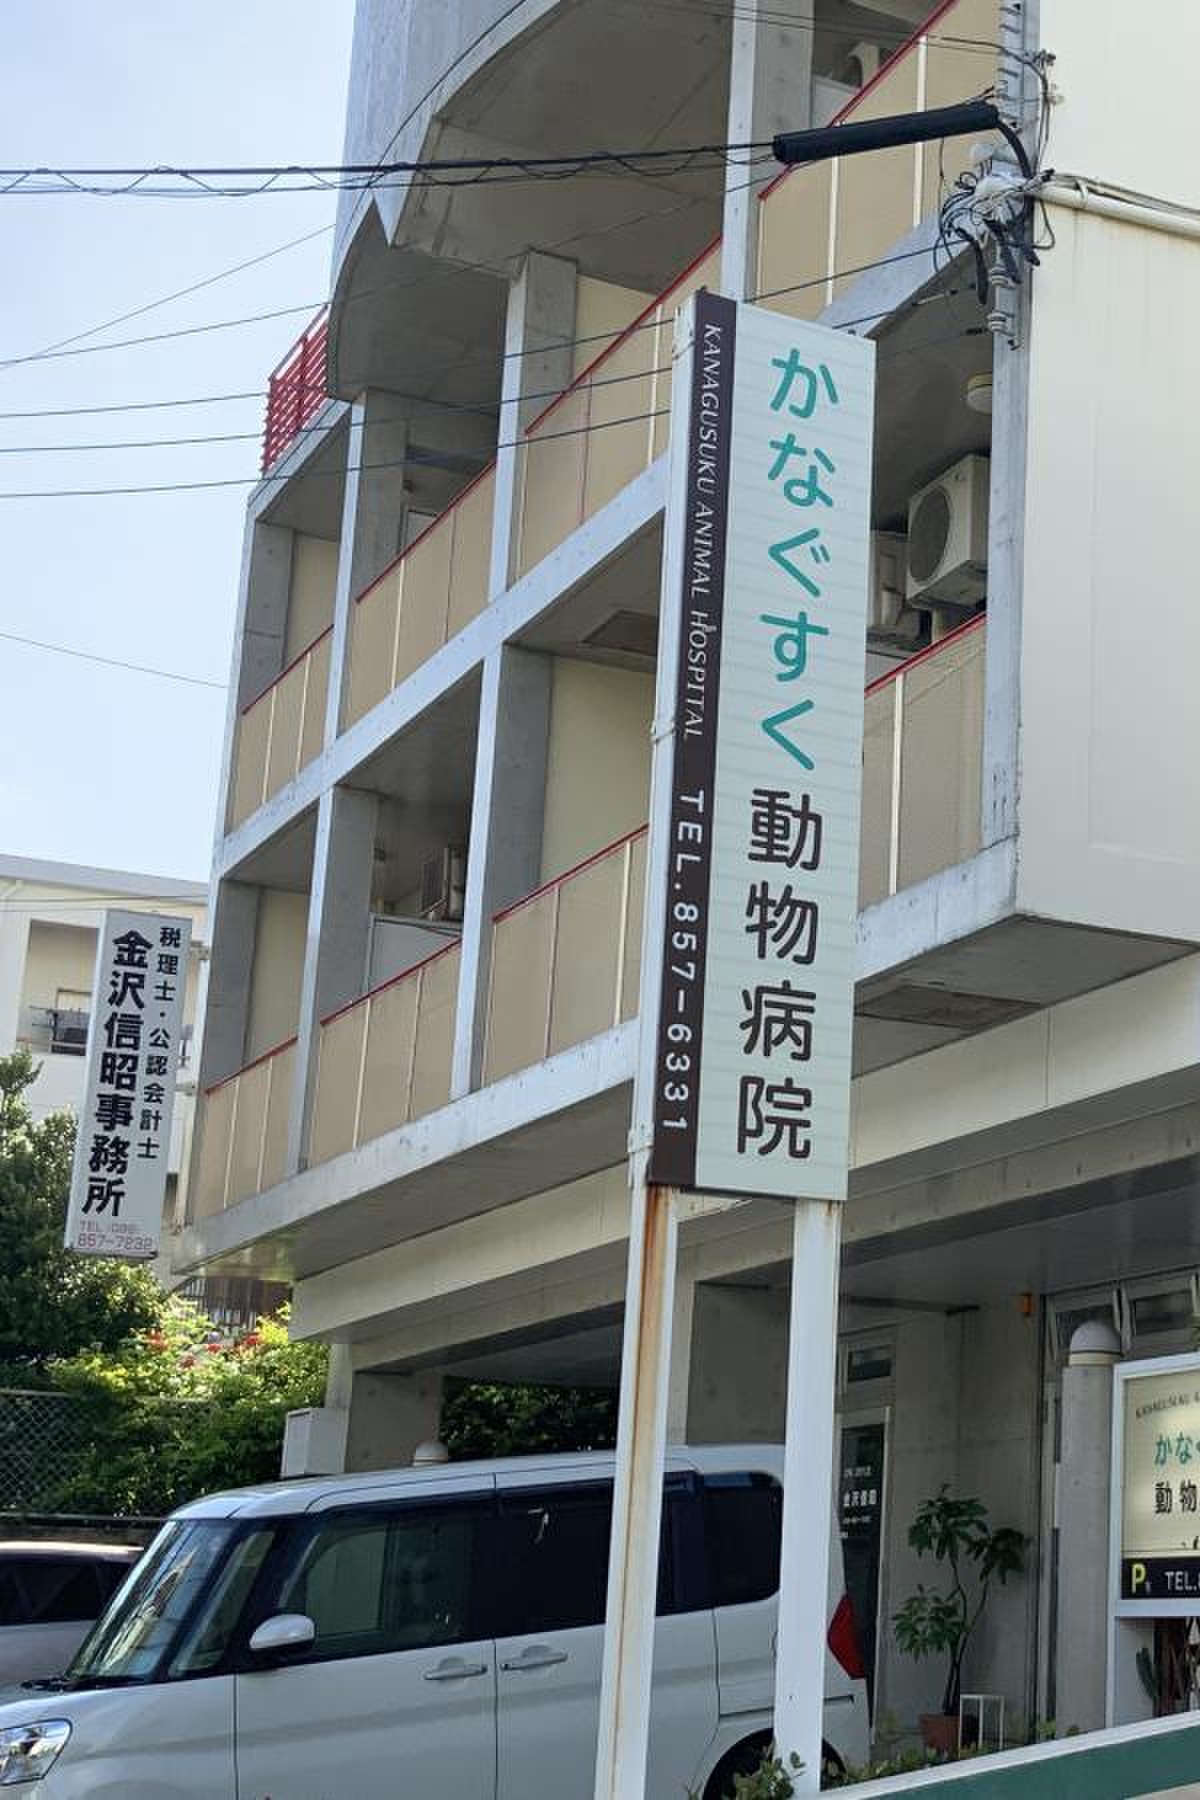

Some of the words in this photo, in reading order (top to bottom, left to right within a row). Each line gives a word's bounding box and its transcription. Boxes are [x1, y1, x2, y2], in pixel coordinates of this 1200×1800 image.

[694, 322, 721, 495] KANAGUSUKU
[689, 501, 714, 598] ANIMAL
[683, 610, 711, 738] HOSPITAL
[737, 348, 839, 1159] かなぐすく動物病院
[81, 930, 153, 1217] 金沢信昭事務所
[662, 789, 704, 1130] TEL.857-6331
